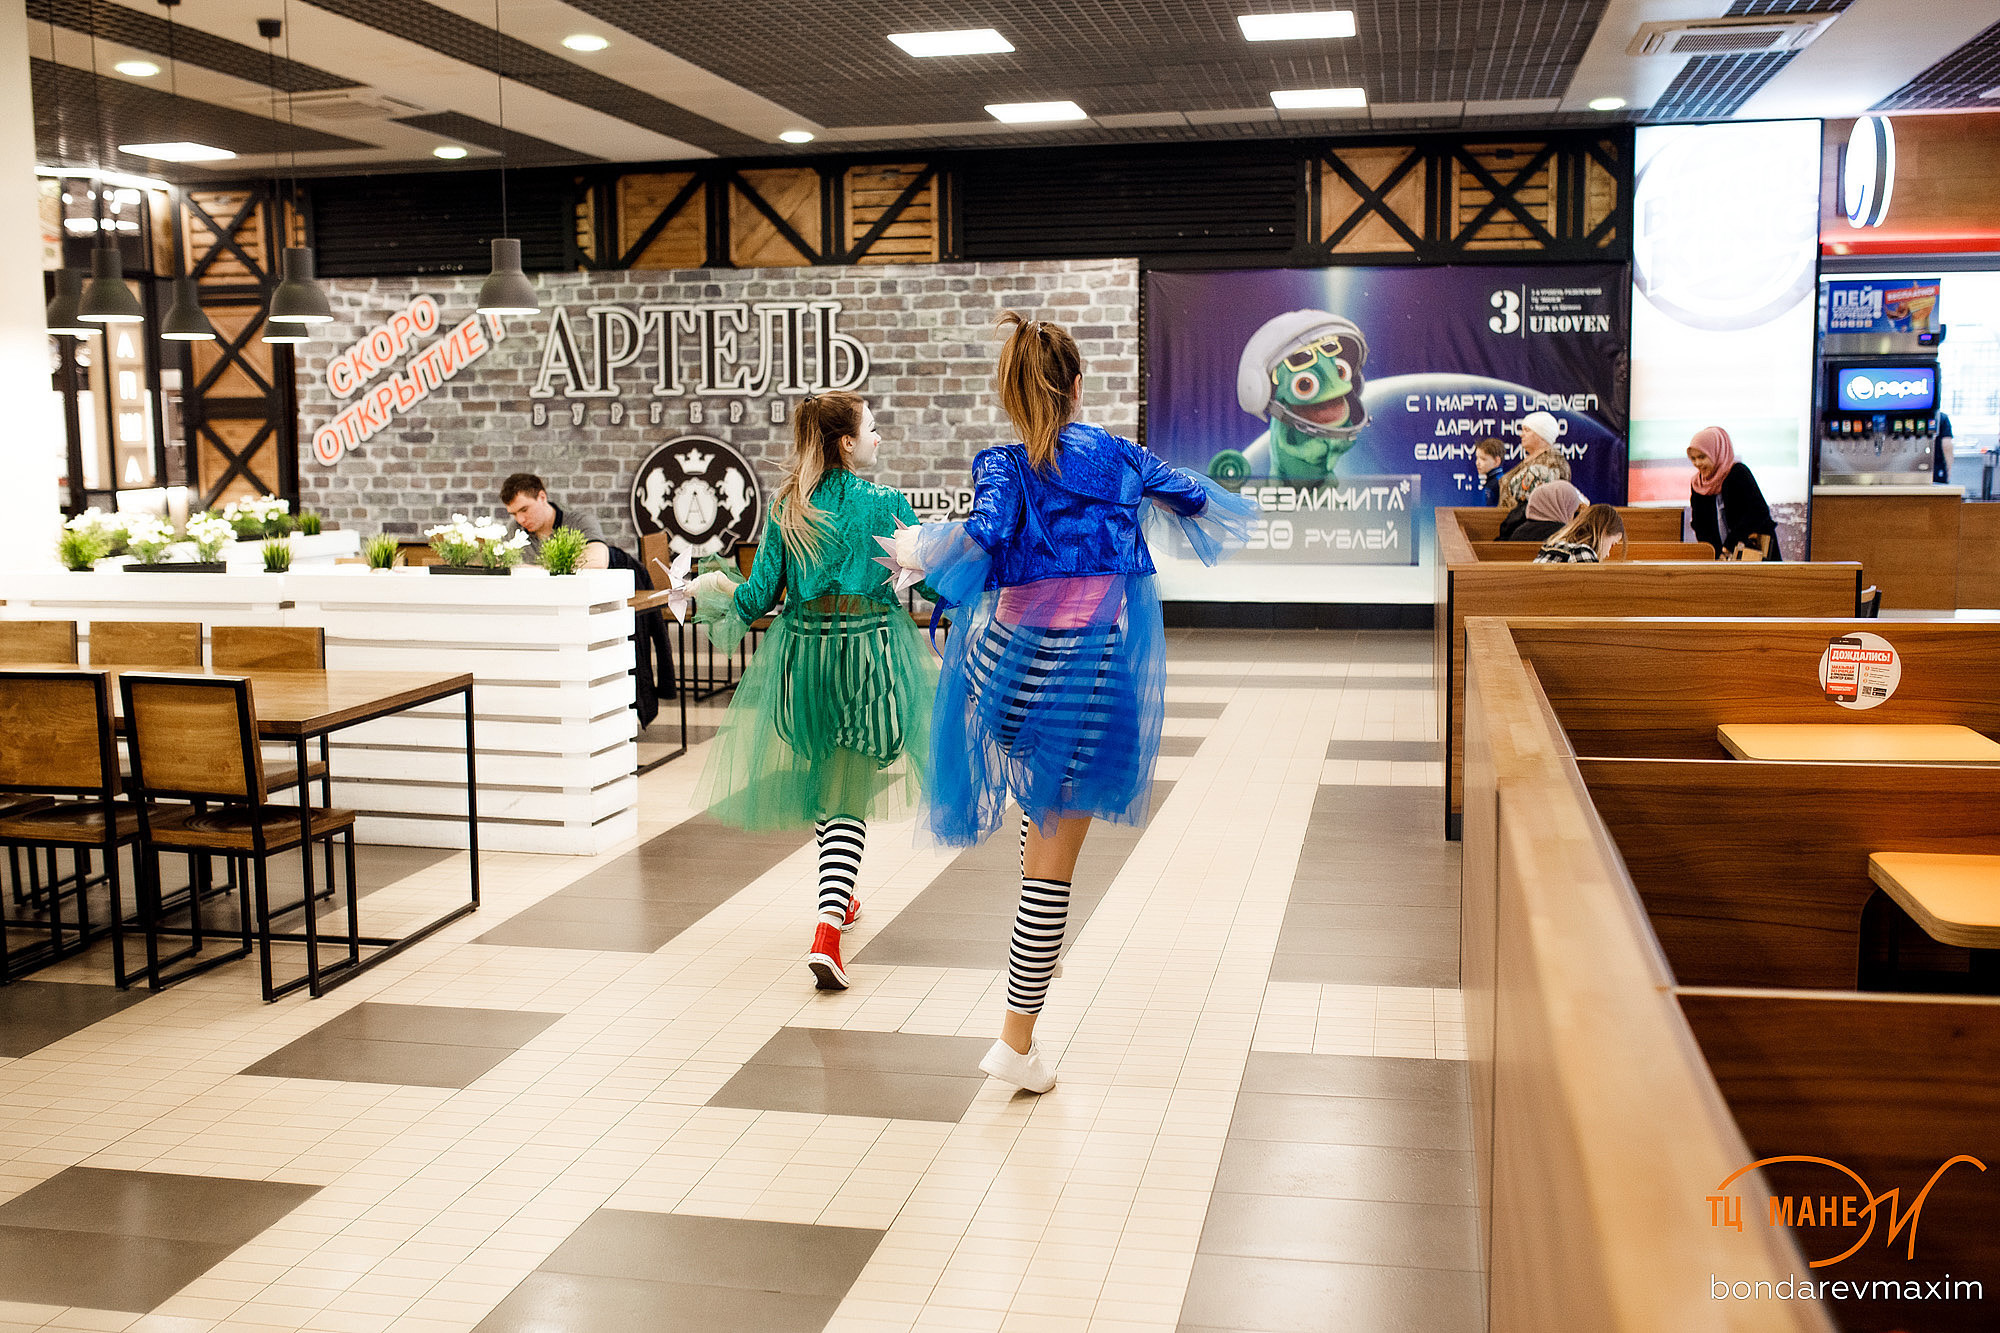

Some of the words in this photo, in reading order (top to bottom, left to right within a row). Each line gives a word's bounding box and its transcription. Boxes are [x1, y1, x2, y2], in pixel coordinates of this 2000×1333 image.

[1489, 290, 1520, 334] 3
[1529, 314, 1611, 333] UROVEN
[1833, 285, 1883, 319] ПЕЙ!
[327, 295, 439, 398] СКОРО
[529, 302, 870, 398] АРТЕЛЬ
[314, 313, 489, 466] ОТКРЫТИЕ
[1406, 395, 1420, 413] С
[1425, 395, 1431, 412] 1
[1435, 394, 1498, 413] МАРТА
[1435, 418, 1497, 437] ДАРИТ
[1304, 519, 1399, 550] РУБЛЕЙ
[1831, 650, 1891, 662] ДОЖДАЛИСЬ!
